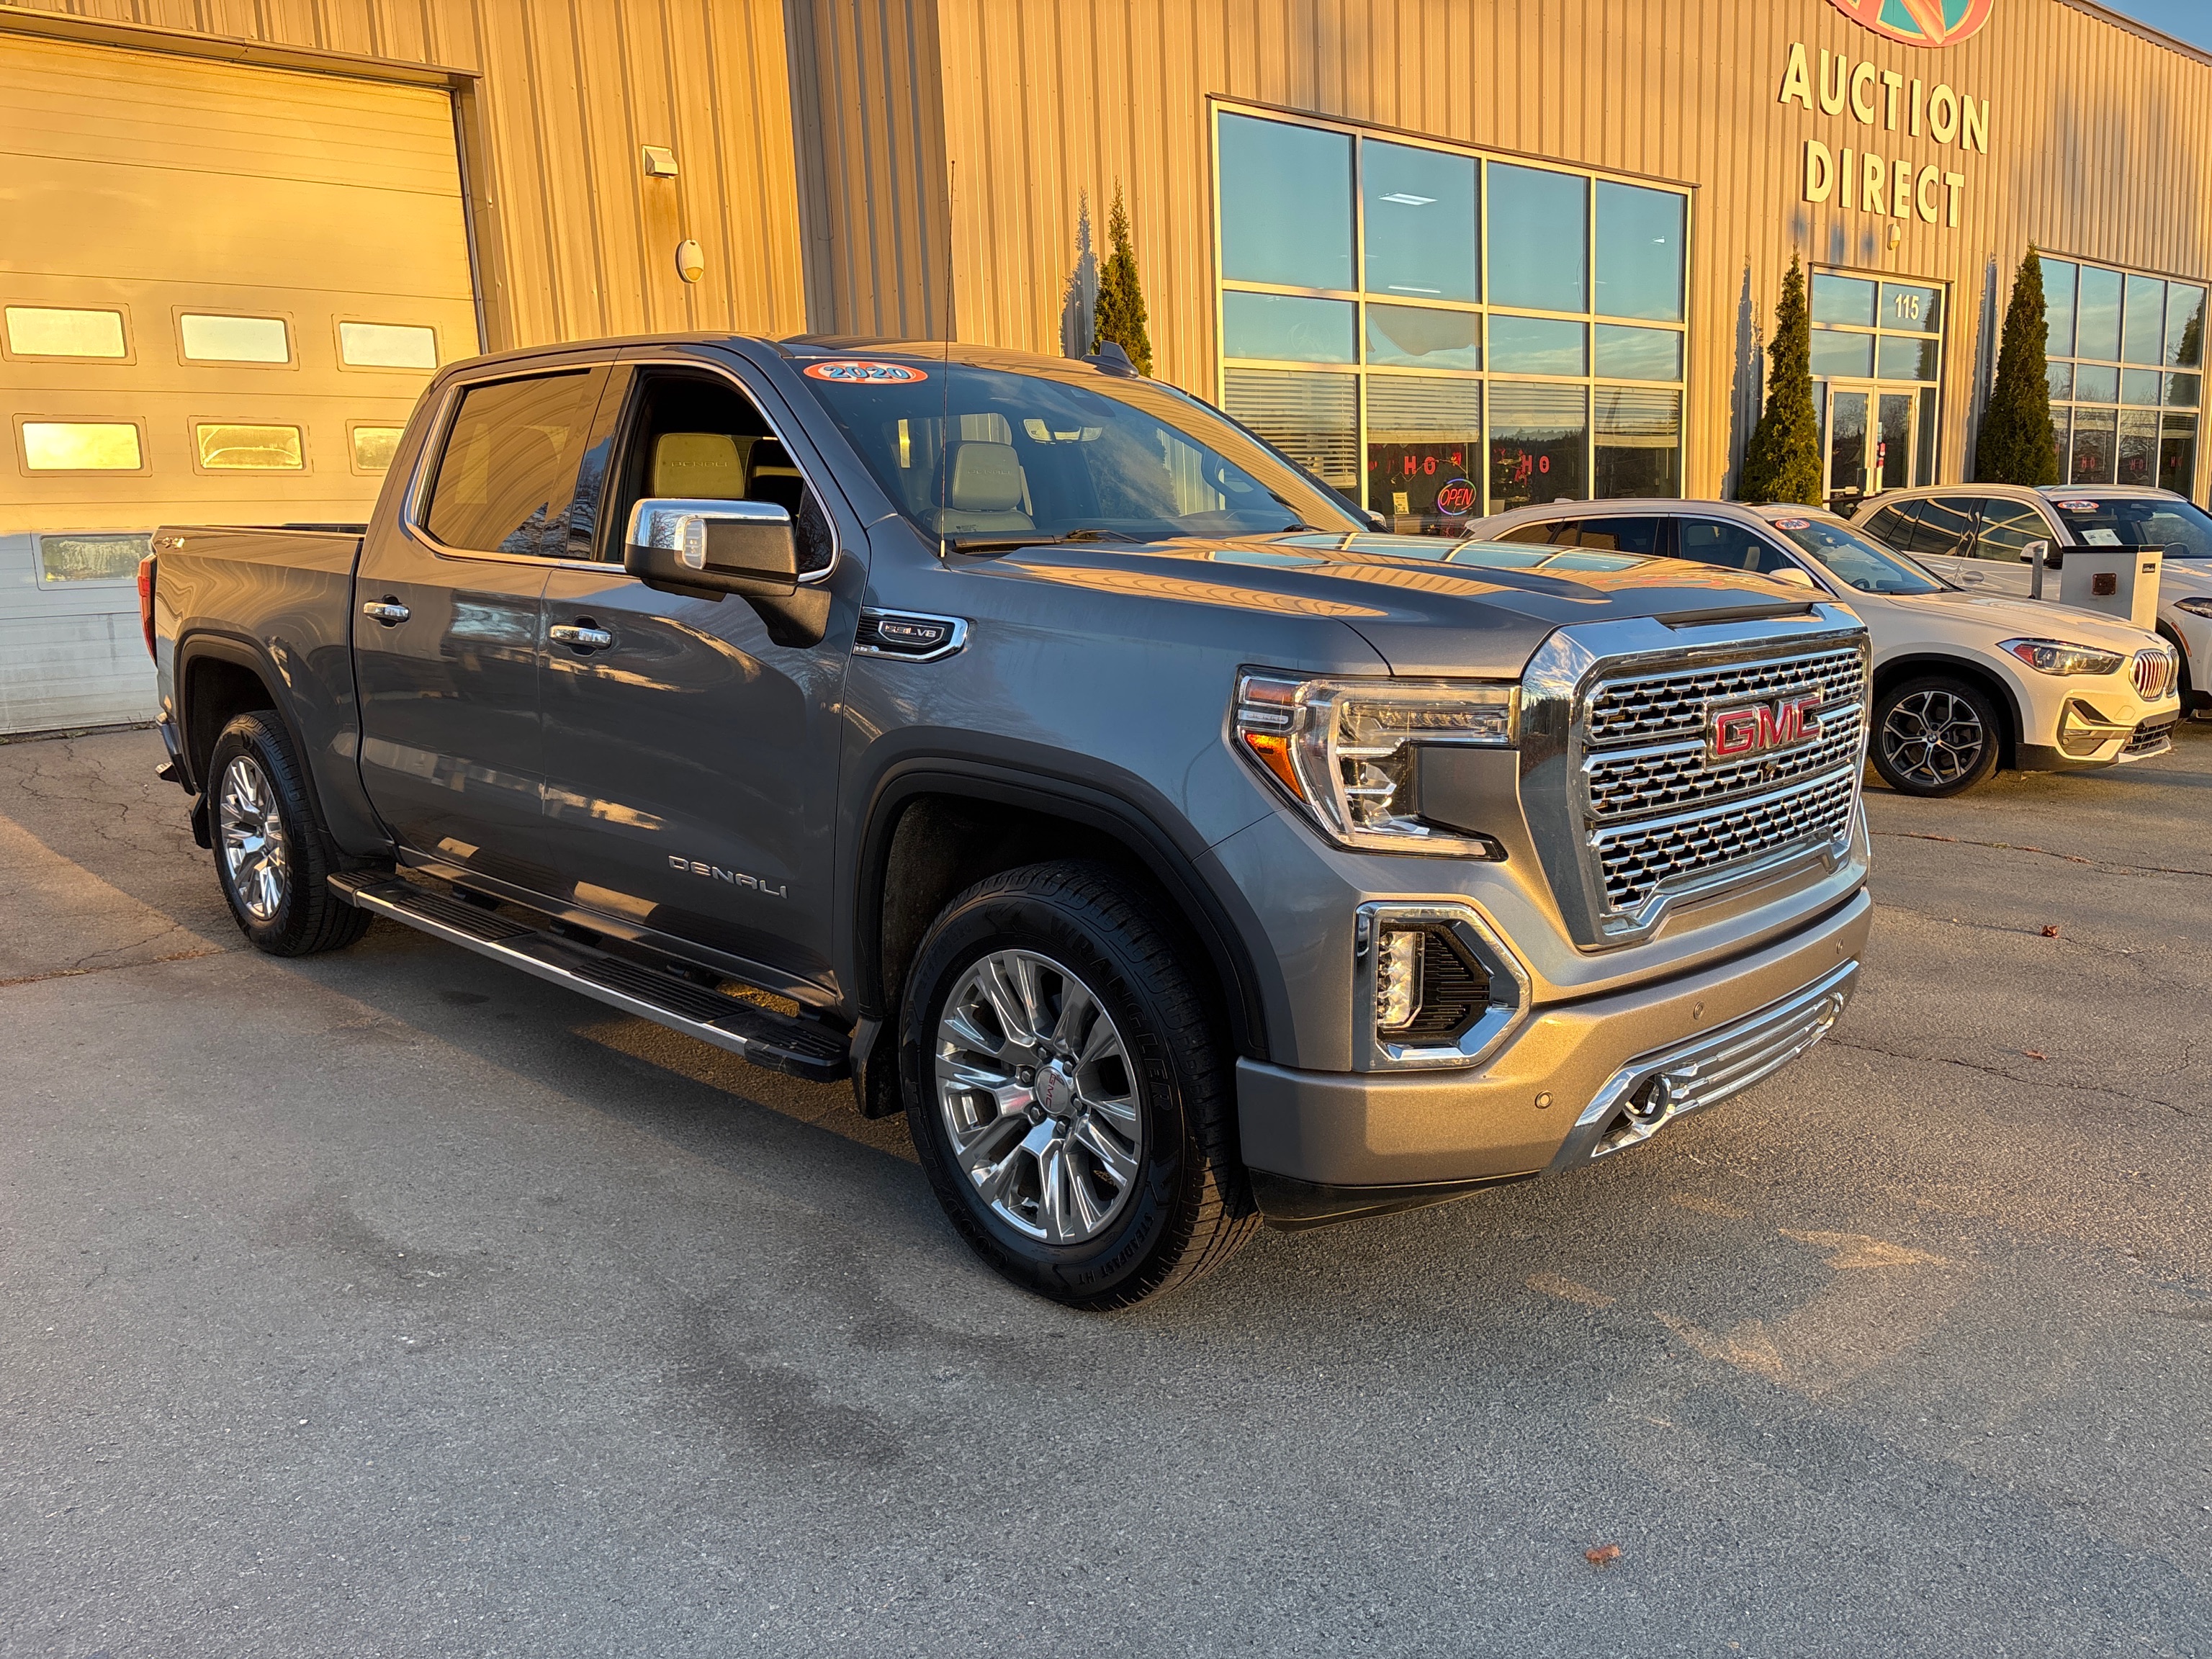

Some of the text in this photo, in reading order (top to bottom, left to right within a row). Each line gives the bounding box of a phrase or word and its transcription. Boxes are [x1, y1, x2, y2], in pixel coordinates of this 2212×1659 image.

[1778, 41, 1990, 154] AUCTION
[1803, 139, 1965, 228] DIRECT
[1895, 293, 1920, 320] 115
[823, 366, 912, 379] 2020
[1440, 488, 1474, 506] OPEN
[1712, 697, 1822, 756] GMC
[667, 855, 788, 899] DENALI
[1049, 915, 1174, 1111] WRANGLER
[1046, 1072, 1056, 1109] GMC
[1101, 1211, 1154, 1279] STEADFAST
